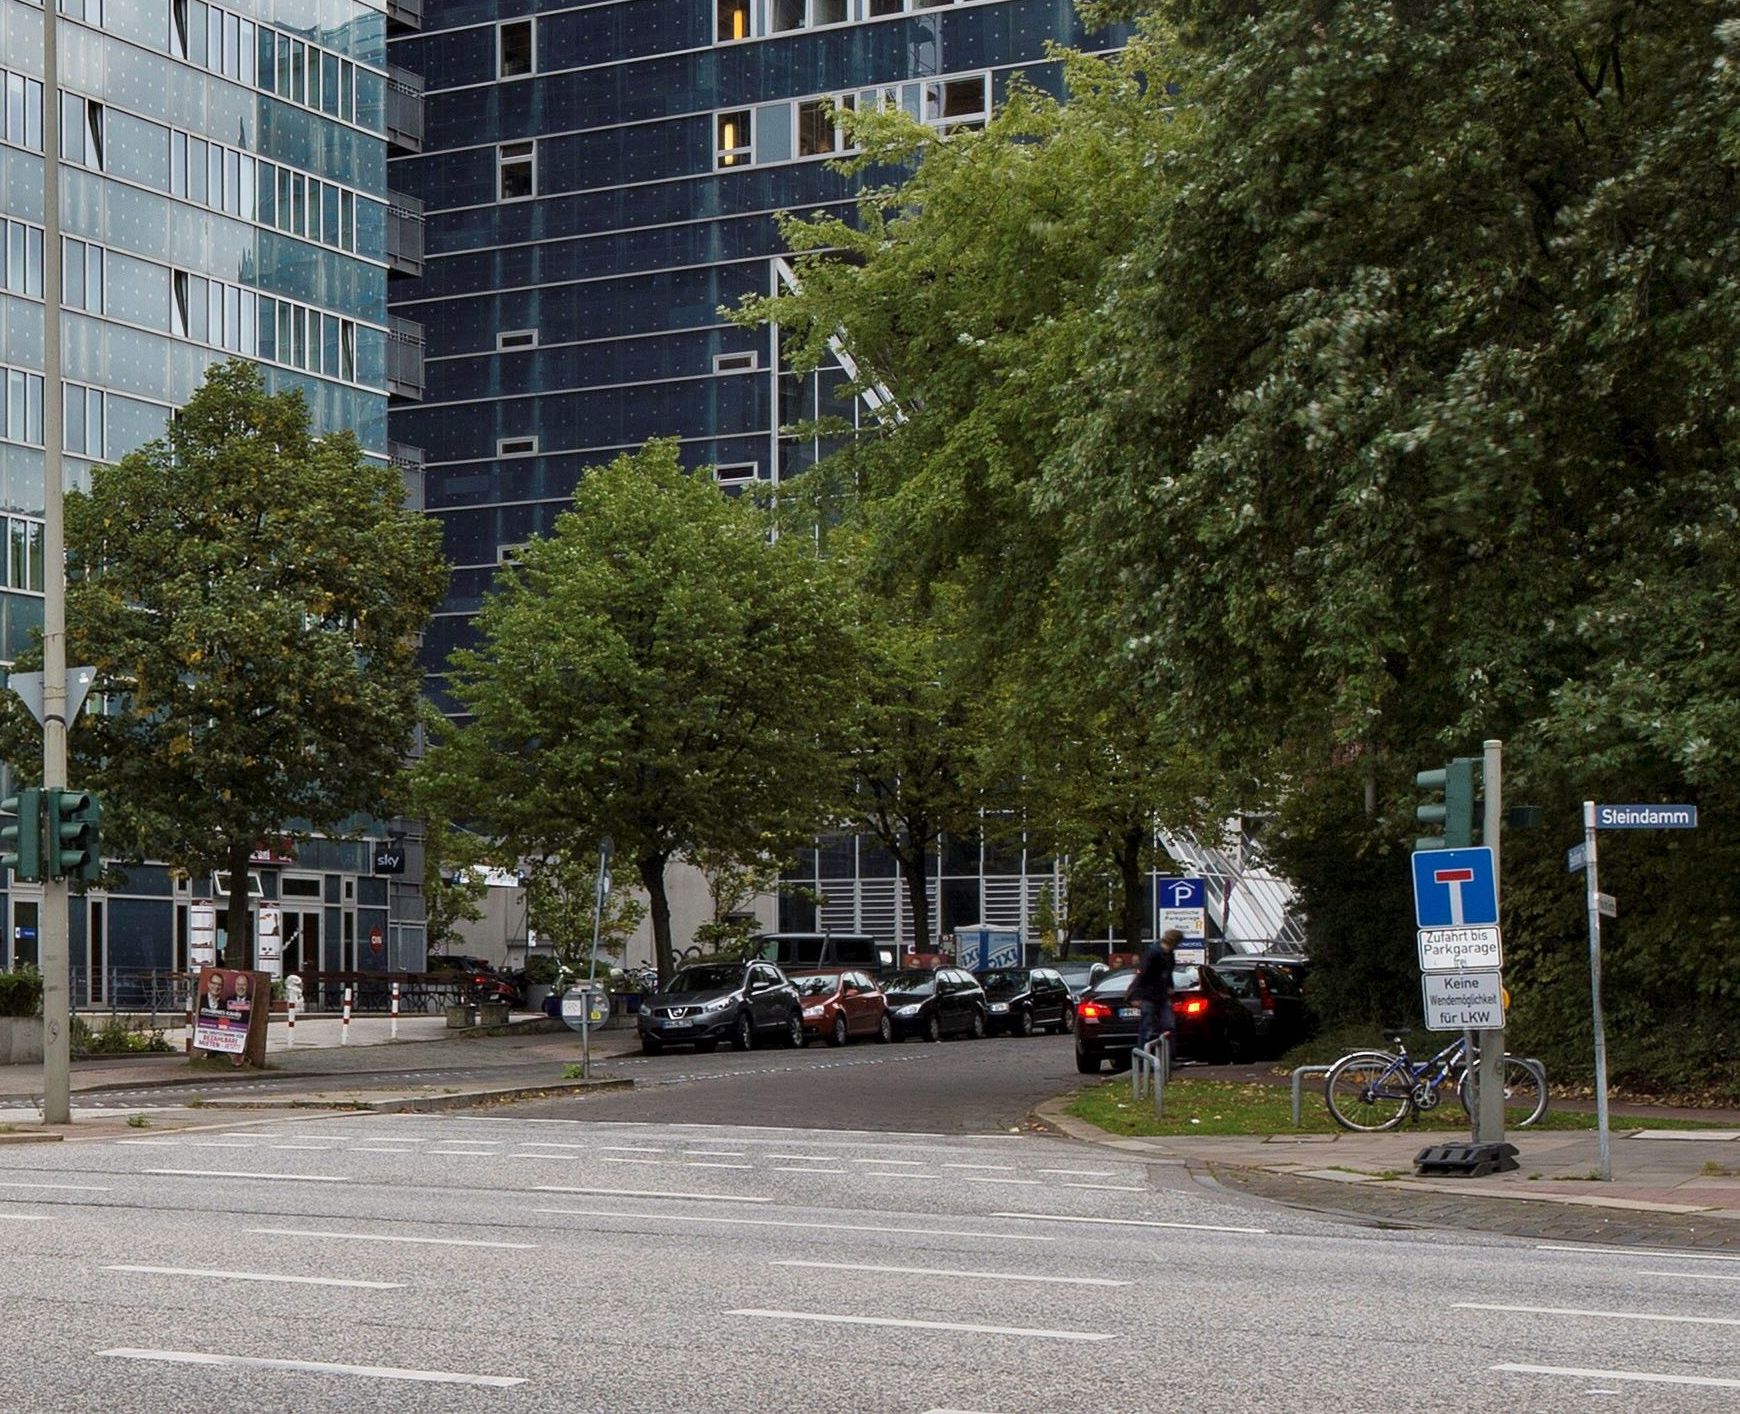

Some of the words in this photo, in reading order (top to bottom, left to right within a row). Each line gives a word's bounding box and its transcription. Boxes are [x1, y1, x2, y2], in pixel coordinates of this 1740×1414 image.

[1602, 808, 1689, 824] Steindamm
[377, 855, 399, 867] sky
[1175, 886, 1193, 907] P
[1426, 930, 1469, 943] Zufahrt
[1471, 930, 1488, 941] bis
[1423, 943, 1497, 956] Parkgarage
[1444, 978, 1480, 990] Keine
[1429, 993, 1497, 1008] Wendemöglichkeit
[1439, 1012, 1458, 1024] für
[1461, 1011, 1490, 1024] LKW
